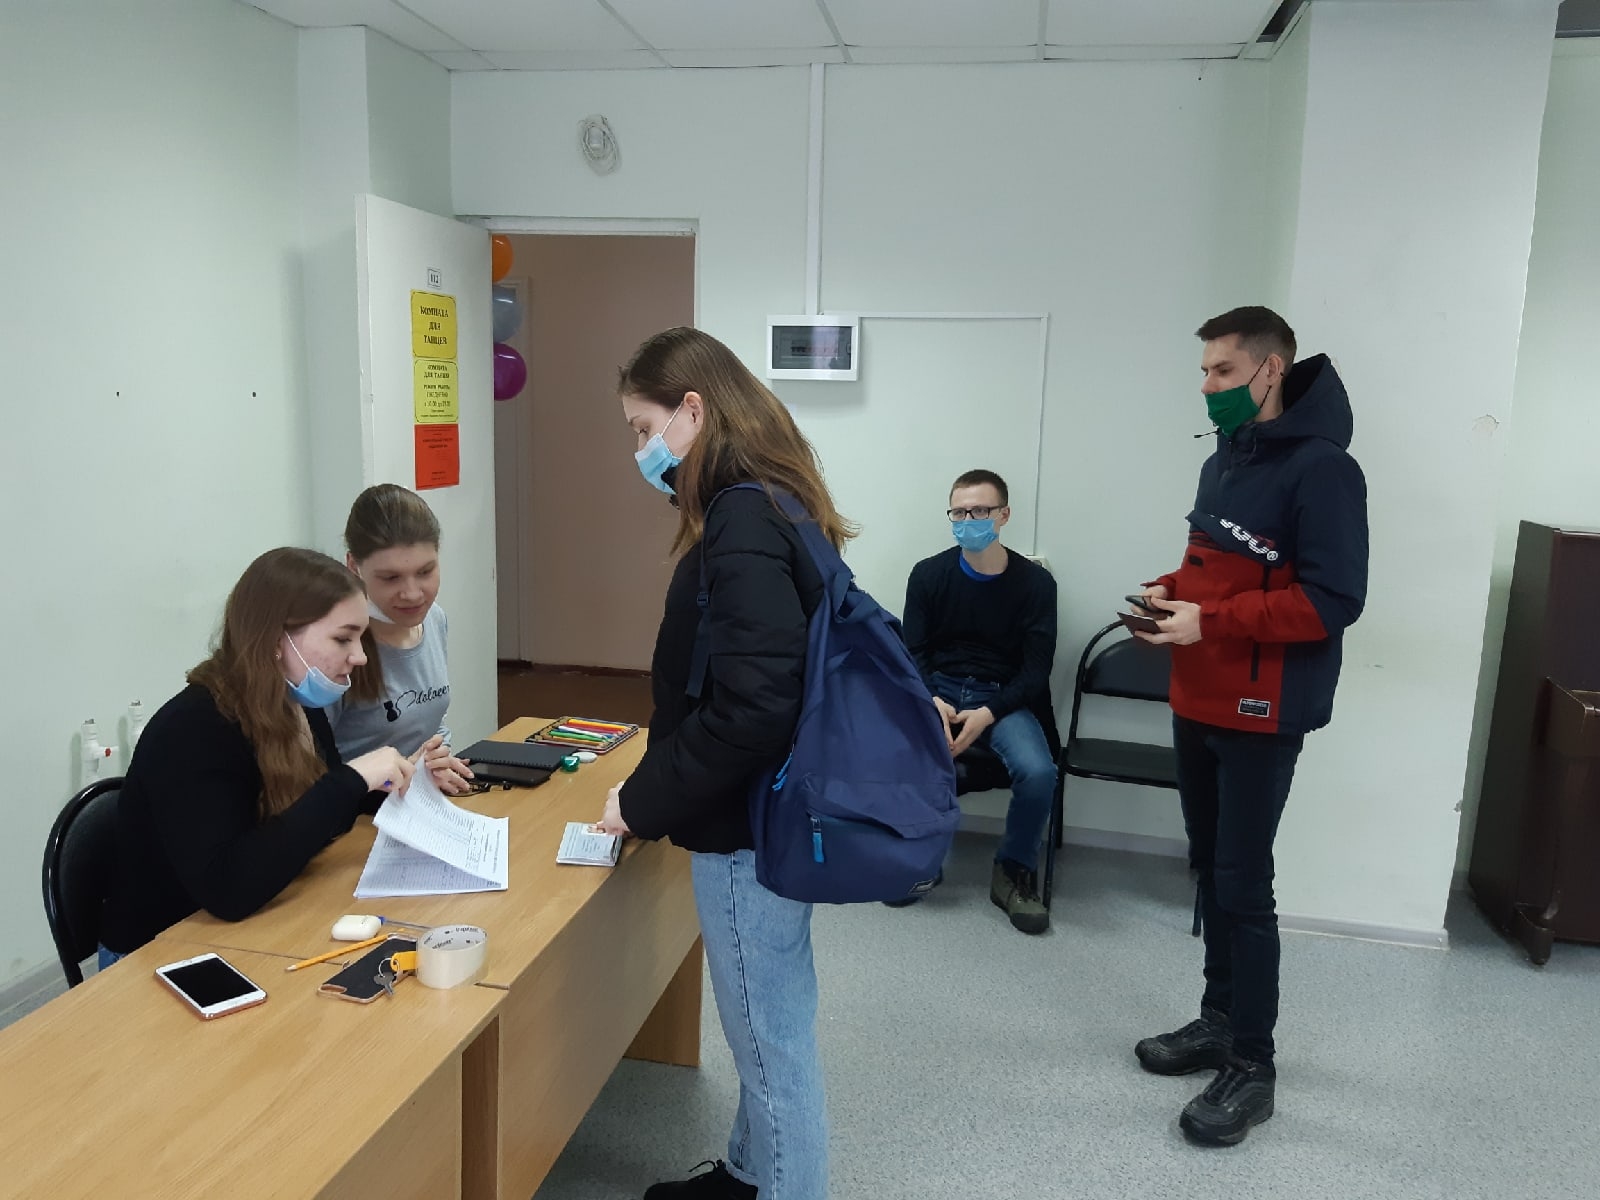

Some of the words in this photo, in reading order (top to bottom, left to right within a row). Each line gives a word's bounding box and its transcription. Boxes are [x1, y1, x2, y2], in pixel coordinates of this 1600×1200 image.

[420, 305, 449, 318] КОМНАТА
[428, 321, 441, 331] ДЛЯ
[423, 334, 448, 346] ТАНЦЕВ
